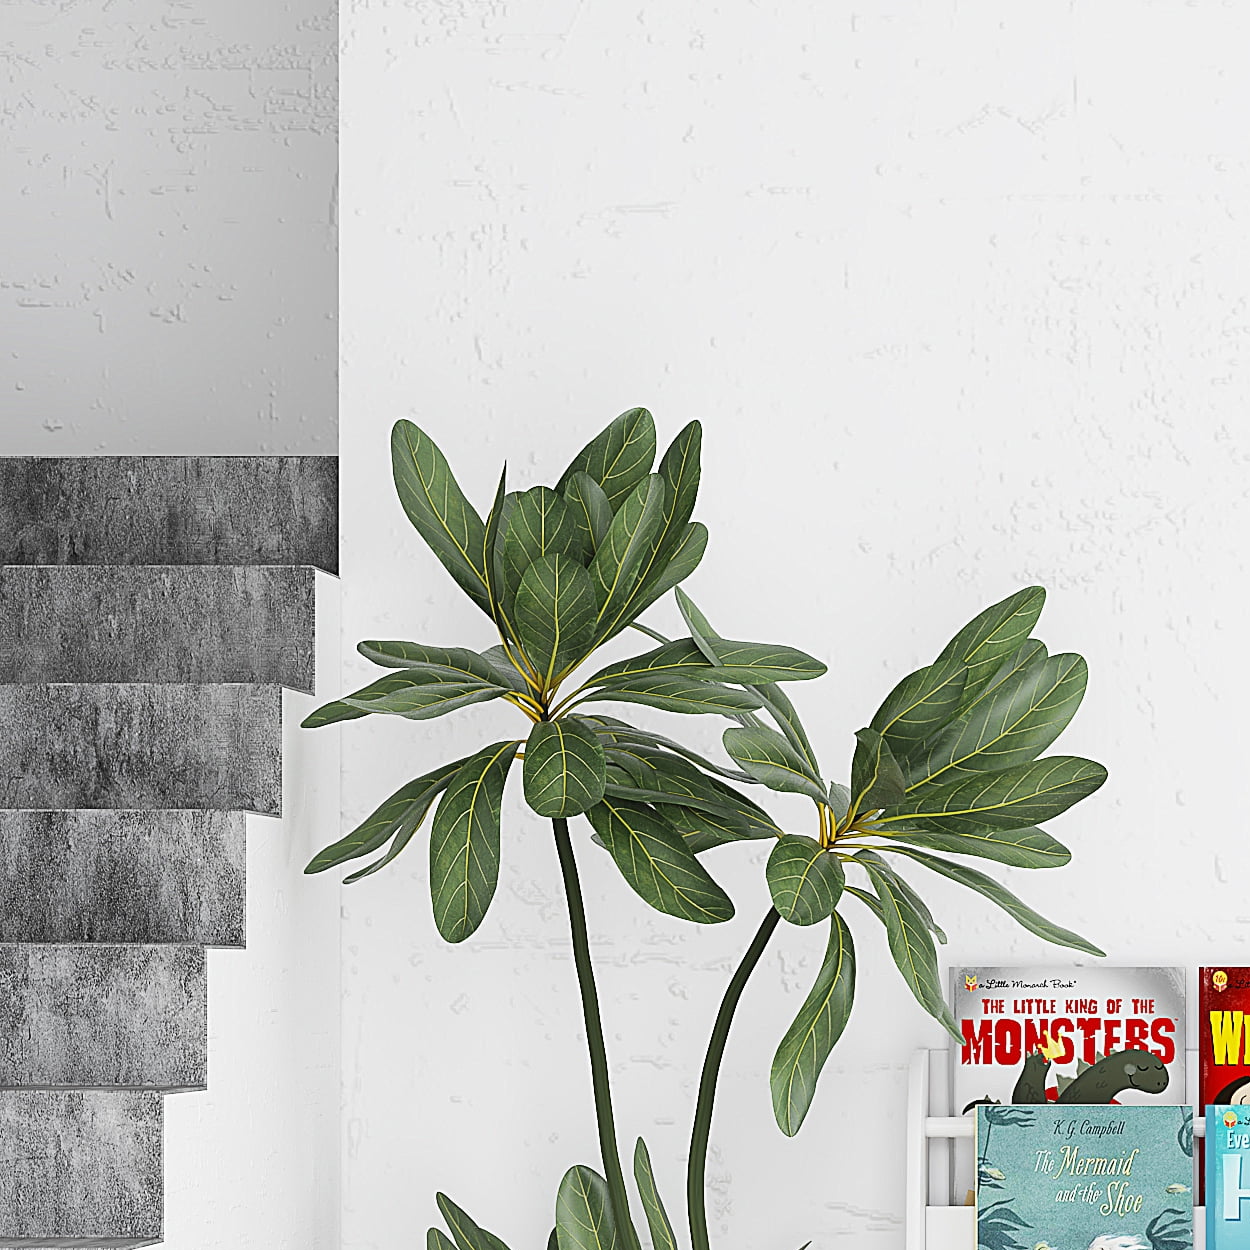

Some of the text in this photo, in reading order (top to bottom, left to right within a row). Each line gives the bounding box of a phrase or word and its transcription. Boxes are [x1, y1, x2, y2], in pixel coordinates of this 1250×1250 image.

[985, 979, 1010, 990] Little
[1011, 979, 1049, 989] Monarch
[982, 998, 1155, 1014] THE LITTLE KING OF THE
[961, 1017, 1176, 1065] MONSTERS
[1080, 1120, 1126, 1138] Campbell
[1034, 1145, 1139, 1180] The Mermaid
[1055, 1180, 1143, 1216] and the Shoe
